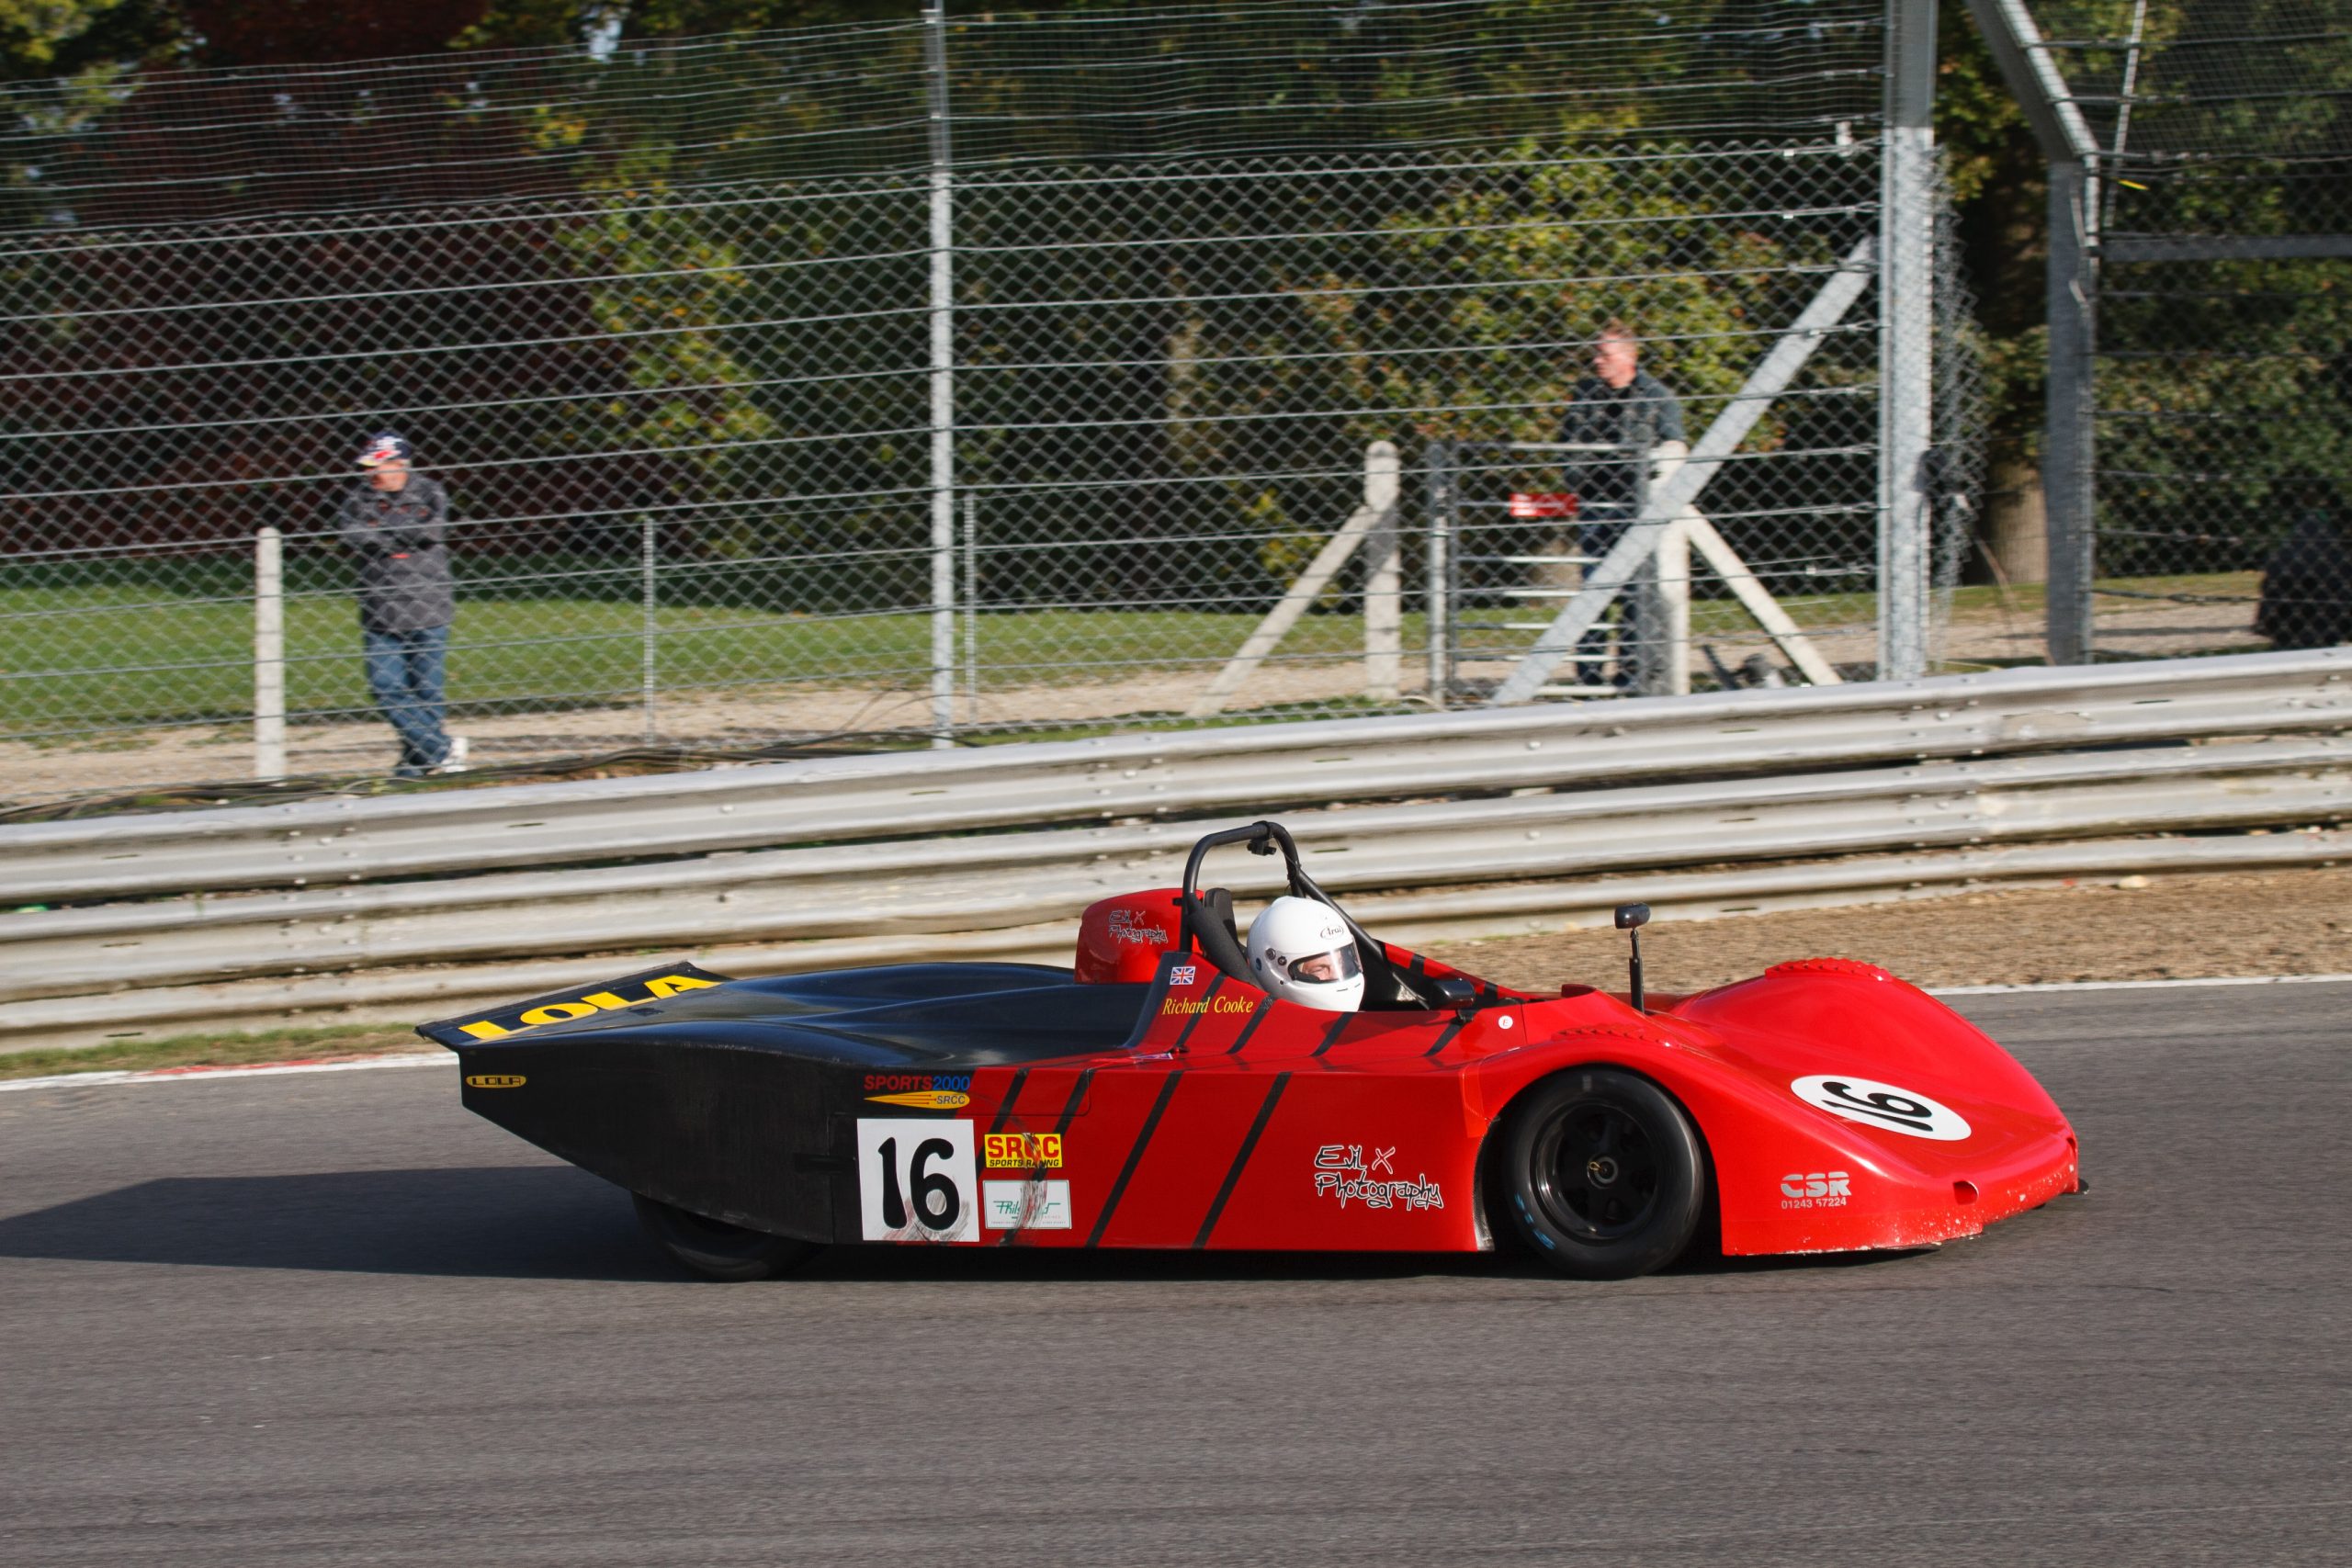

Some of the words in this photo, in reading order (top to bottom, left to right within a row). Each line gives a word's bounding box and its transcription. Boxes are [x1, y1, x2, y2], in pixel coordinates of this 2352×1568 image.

[1134, 910, 1146, 926] X
[458, 975, 724, 1042] LOLA
[1161, 996, 1211, 1015] Richard
[1214, 995, 1254, 1013] Cooke
[471, 1077, 522, 1086] LOLA
[864, 1075, 970, 1091] SPORTS2000
[936, 1095, 966, 1105] SRCC
[1821, 1080, 1934, 1133] 16
[988, 1136, 1059, 1158] SRCC
[1372, 1146, 1396, 1175] X
[877, 1136, 960, 1231] 16
[1314, 1169, 1444, 1211] Photography
[1780, 1171, 1852, 1198] CSR
[1781, 1199, 1813, 1209] 01243
